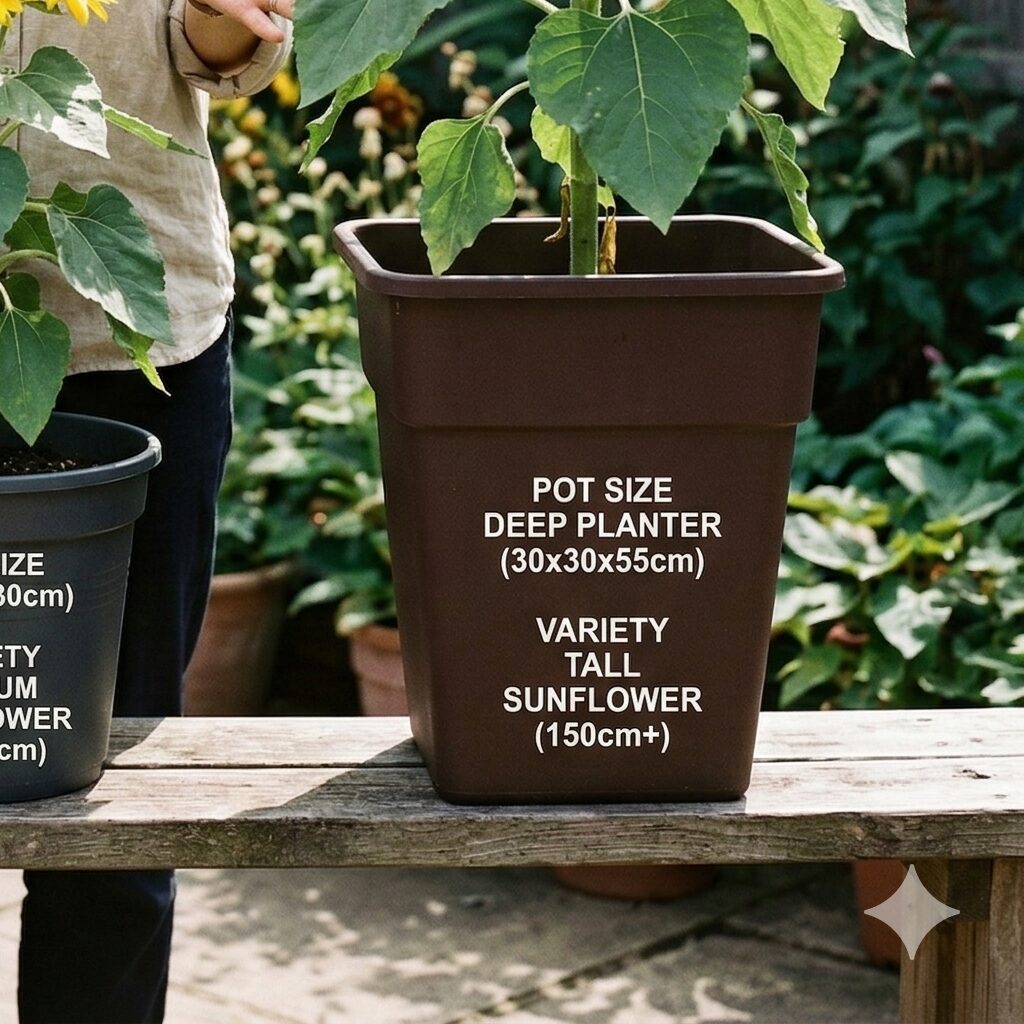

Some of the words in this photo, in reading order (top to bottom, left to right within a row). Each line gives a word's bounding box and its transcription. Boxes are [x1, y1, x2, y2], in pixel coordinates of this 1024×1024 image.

[533, 476, 595, 503] POT
[604, 476, 673, 503] SIZE
[484, 512, 567, 538] DEEP
[577, 512, 722, 538] PLANTER
[500, 547, 705, 579] (30x30x55cm)
[535, 617, 670, 643] VARIETY
[564, 652, 641, 678] TALL
[503, 686, 703, 713] SUNFLOWER
[534, 721, 671, 753] (150cm+)
